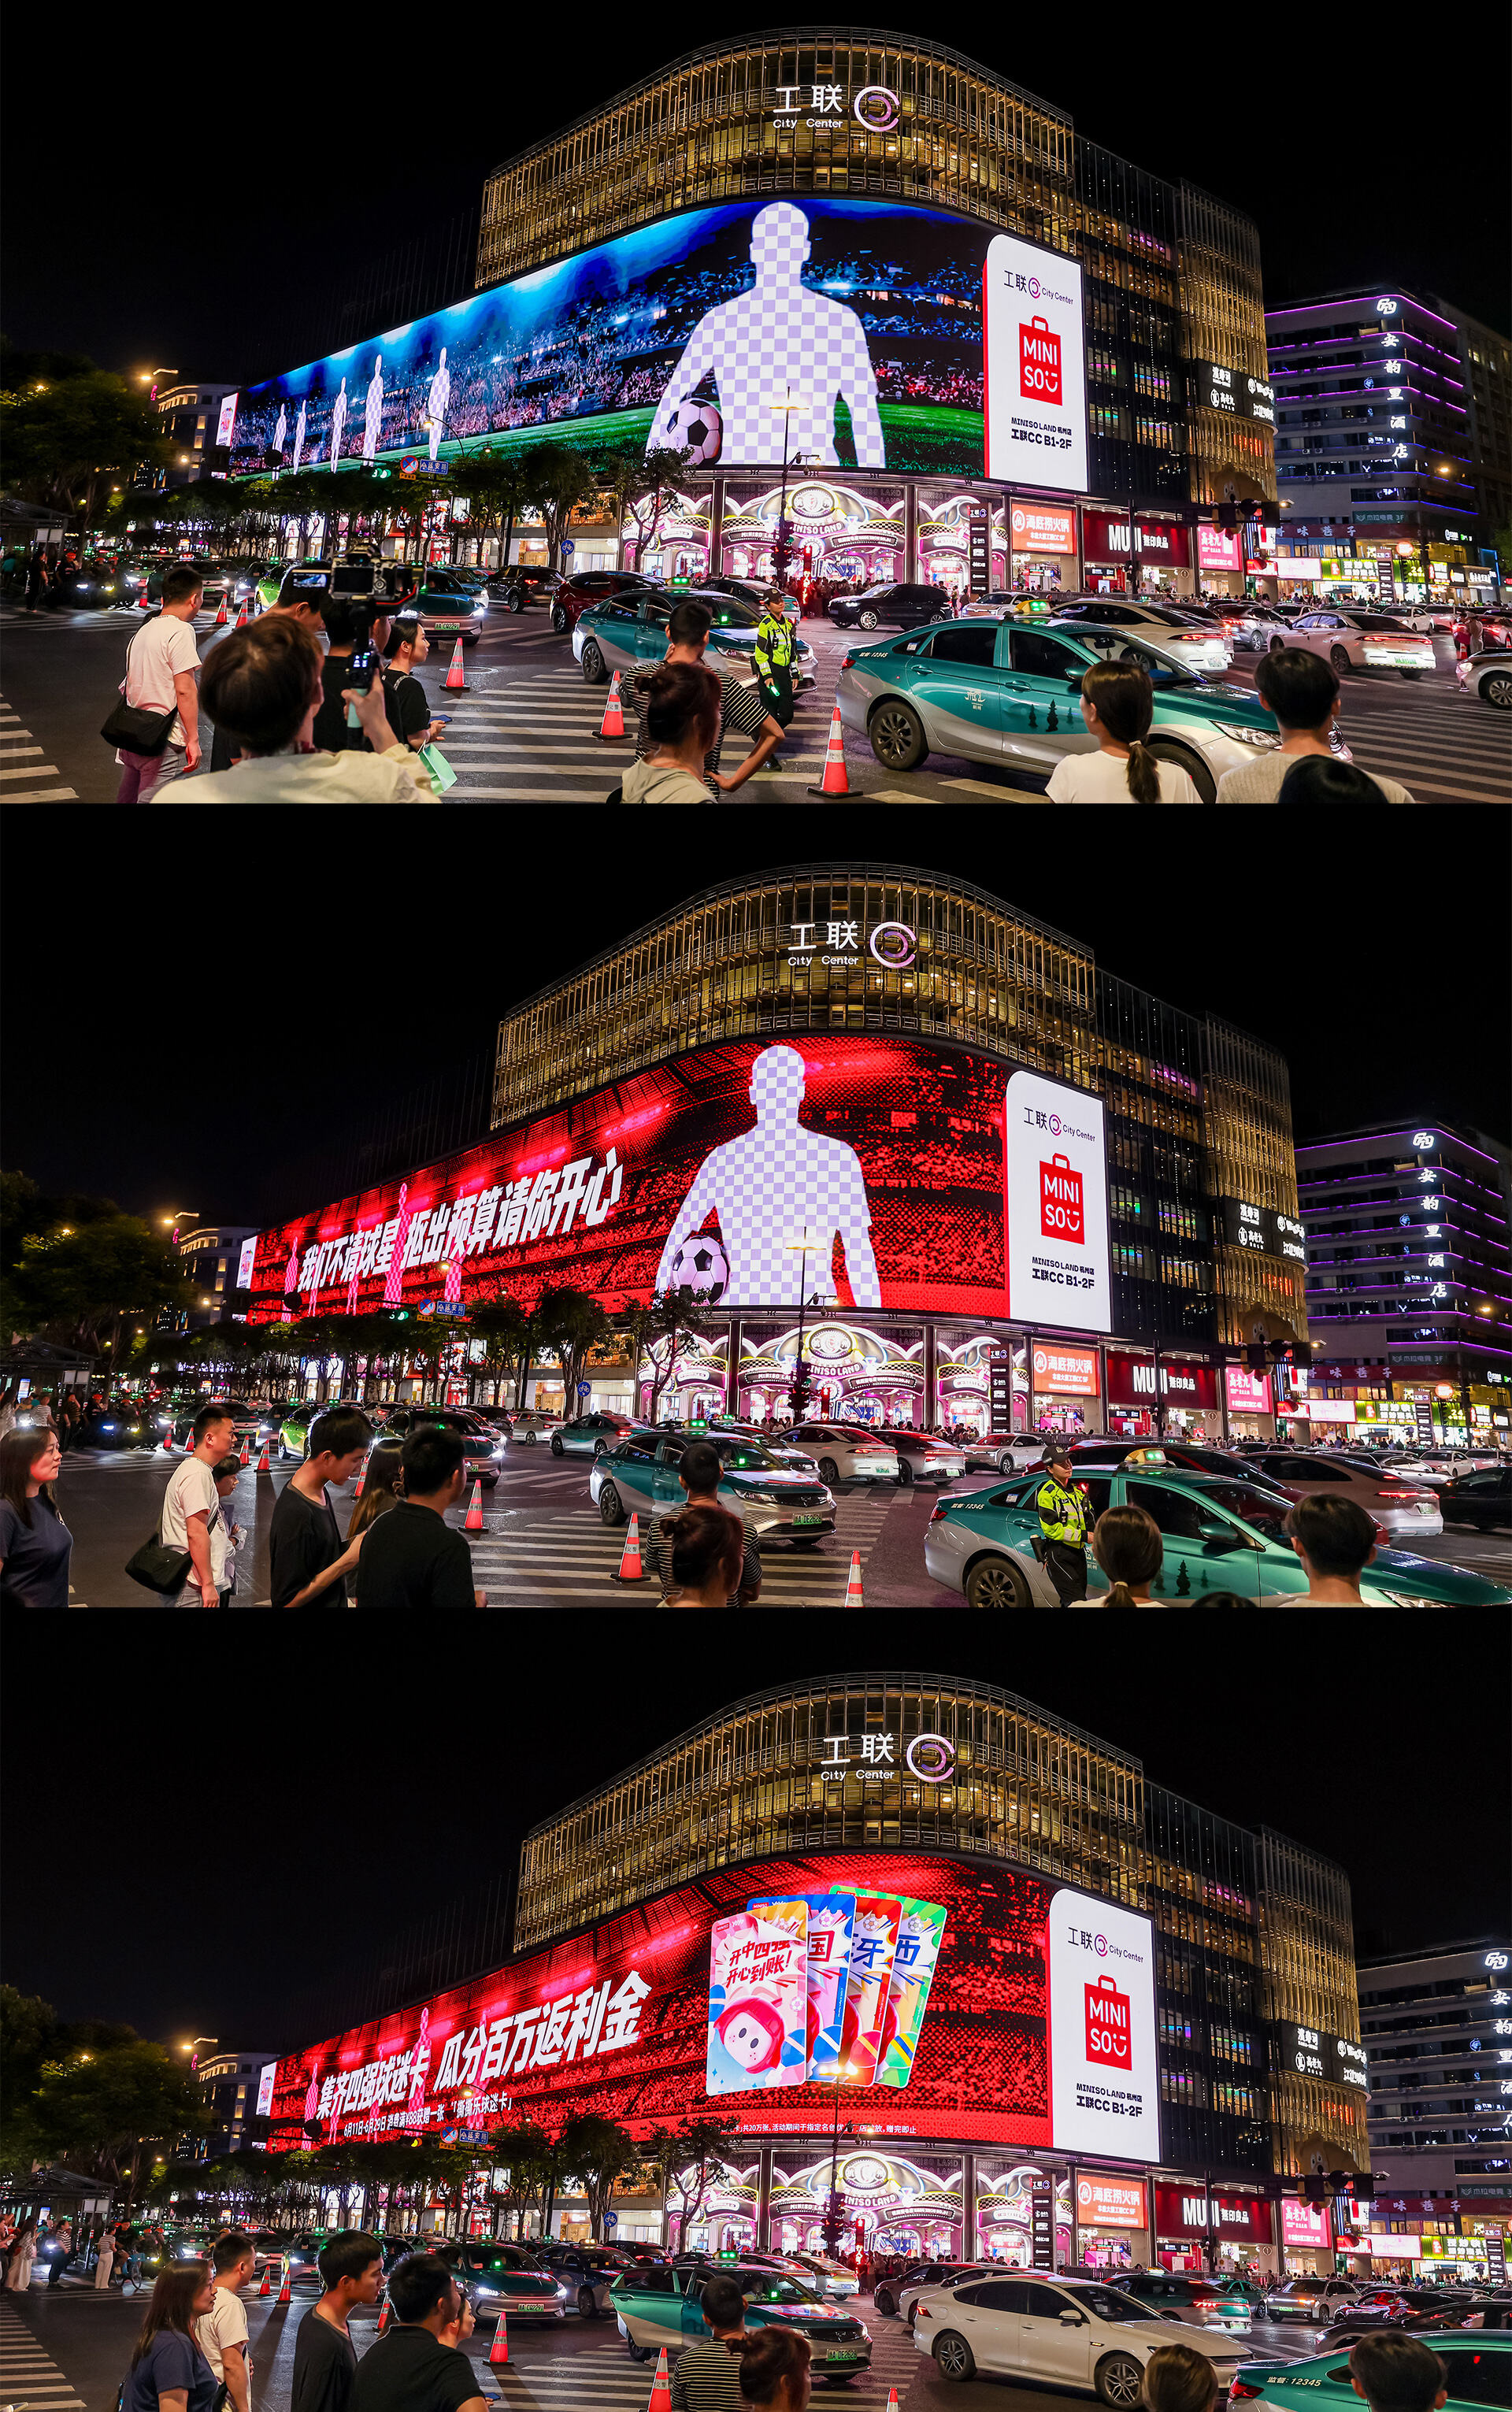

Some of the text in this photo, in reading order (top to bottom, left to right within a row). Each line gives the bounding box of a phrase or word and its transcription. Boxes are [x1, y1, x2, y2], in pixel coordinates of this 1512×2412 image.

[773, 84, 843, 113] 工联
[773, 118, 843, 129] City Center
[1004, 270, 1073, 305] 工联 City Center
[1024, 335, 1057, 365] MINI
[1380, 333, 1408, 459] 安韵里酒店
[1011, 417, 1039, 428] MINISO
[1039, 423, 1056, 433] LAND
[1011, 428, 1072, 450] 工联CC B1-2F
[791, 522, 843, 535] INISO LAND
[1026, 514, 1069, 532] 海底捞火锅
[1143, 535, 1169, 548] 無印良品
[788, 921, 858, 950] 工联
[788, 955, 859, 967] City Center
[1024, 1106, 1095, 1142] 工联 City Center
[1044, 1173, 1080, 1204] MINI
[296, 1147, 624, 1294] 我们不请球星 抠出预算请你开心
[1418, 1168, 1447, 1298] 安韵里酒店
[1032, 1256, 1060, 1269] MINISO
[1060, 1262, 1079, 1273] LAND
[1032, 1268, 1095, 1289] 工联CC B1-2F
[809, 1364, 860, 1376] INISO LAND
[1047, 1355, 1092, 1374] 海底捞火锅
[1169, 1376, 1196, 1391] 無印良品
[821, 1733, 894, 1765] 工联
[821, 1769, 895, 1781] City Center
[807, 1930, 835, 1962] 国
[851, 1933, 885, 1969] 牙
[895, 1934, 921, 1966] 西
[1068, 1927, 1143, 1963] 工联 City Center
[1089, 1996, 1126, 2028] MINI
[315, 1970, 652, 2121] 集齐四强球迷卡 瓜分百万返利金
[1076, 2083, 1142, 2103] MINISO LAND 杭州店
[1076, 2095, 1142, 2117] 工联CC B1-2F
[343, 2115, 387, 2137] 6月11日-6月29日
[843, 2194, 896, 2206] INISO LAND
[1093, 2187, 1140, 2206] 海底捞火锅
[1221, 2208, 1249, 2224] 無印良品
[1291, 2377, 1321, 2387] 12345
